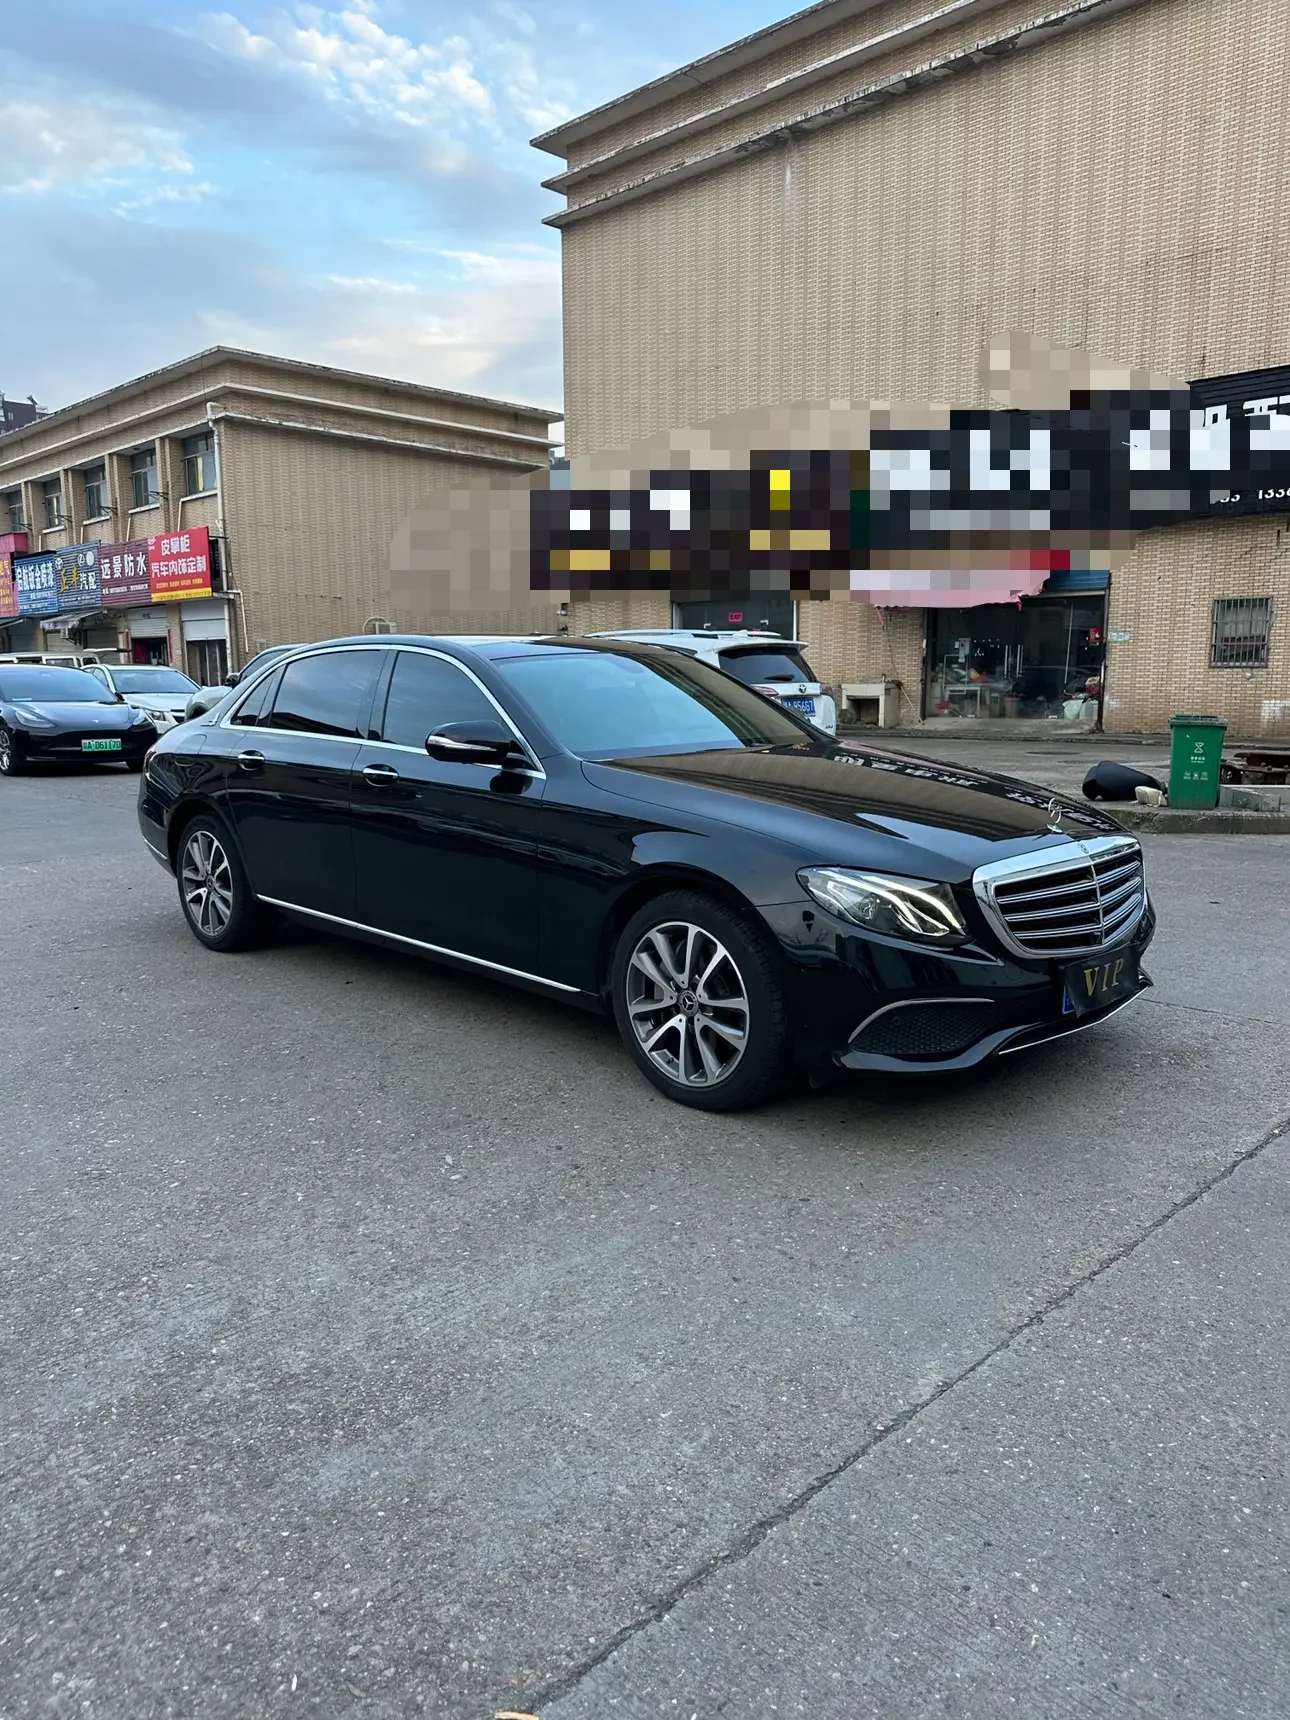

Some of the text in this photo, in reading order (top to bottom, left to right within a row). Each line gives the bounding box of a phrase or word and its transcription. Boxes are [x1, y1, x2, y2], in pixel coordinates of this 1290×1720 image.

[161, 534, 190, 556] 皮掌柜
[101, 552, 146, 579] 远景防水
[151, 555, 206, 578] 汽车内饰定制
[1083, 958, 1125, 997] VIP
